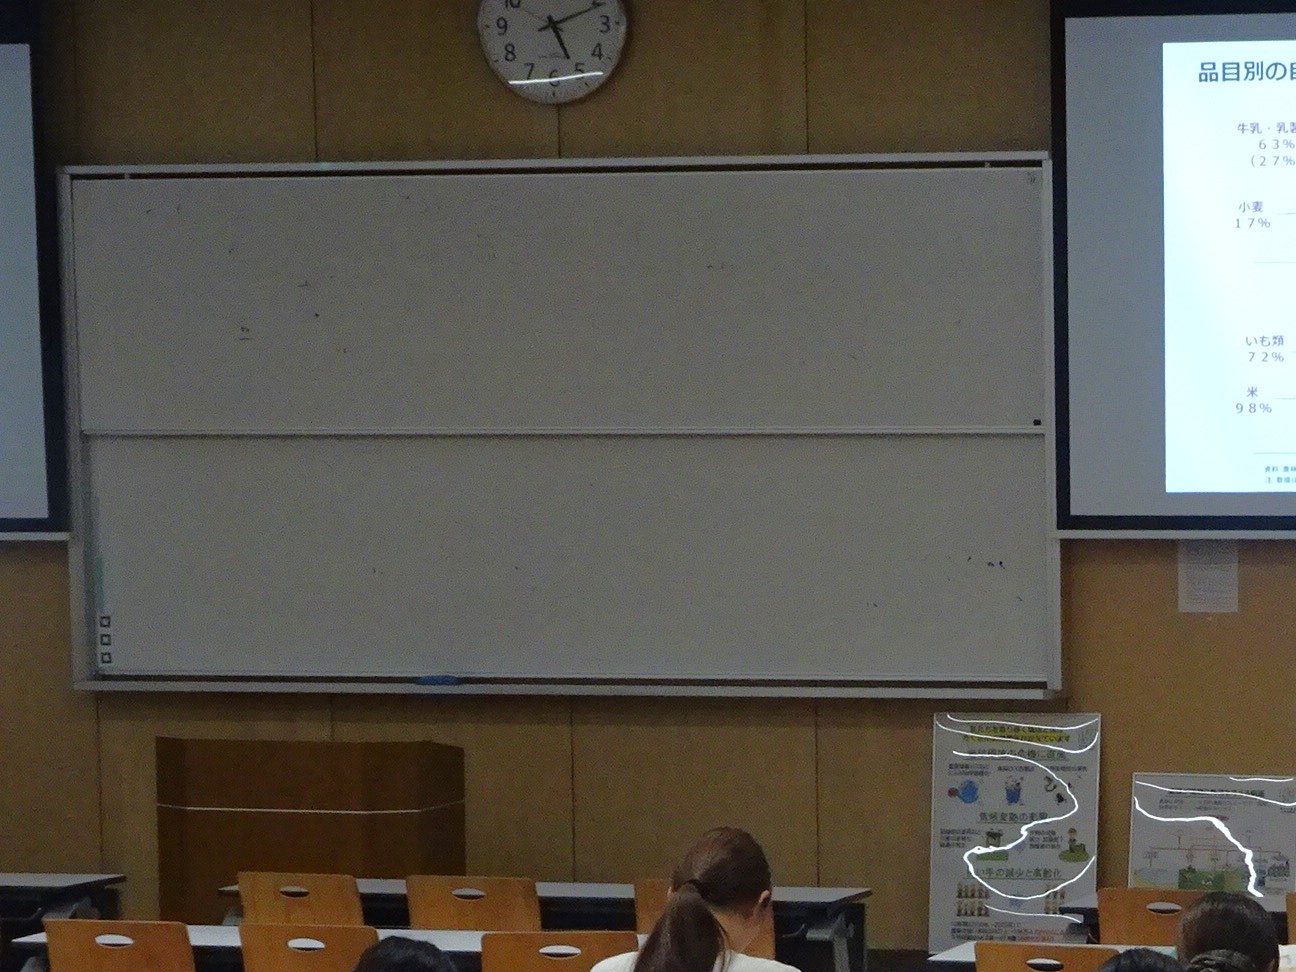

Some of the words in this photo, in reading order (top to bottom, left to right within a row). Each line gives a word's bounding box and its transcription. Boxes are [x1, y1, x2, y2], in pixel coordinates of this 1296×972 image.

[496, 17, 508, 35] 9
[600, 15, 611, 33] 3
[504, 43, 517, 62] 8
[591, 43, 603, 61] 4
[524, 62, 535, 80] 7
[549, 69, 560, 87] 6
[574, 62, 585, 81] 5
[1239, 201, 1264, 213] 小麦
[1246, 335, 1285, 347] いも類
[1247, 386, 1259, 398] 米
